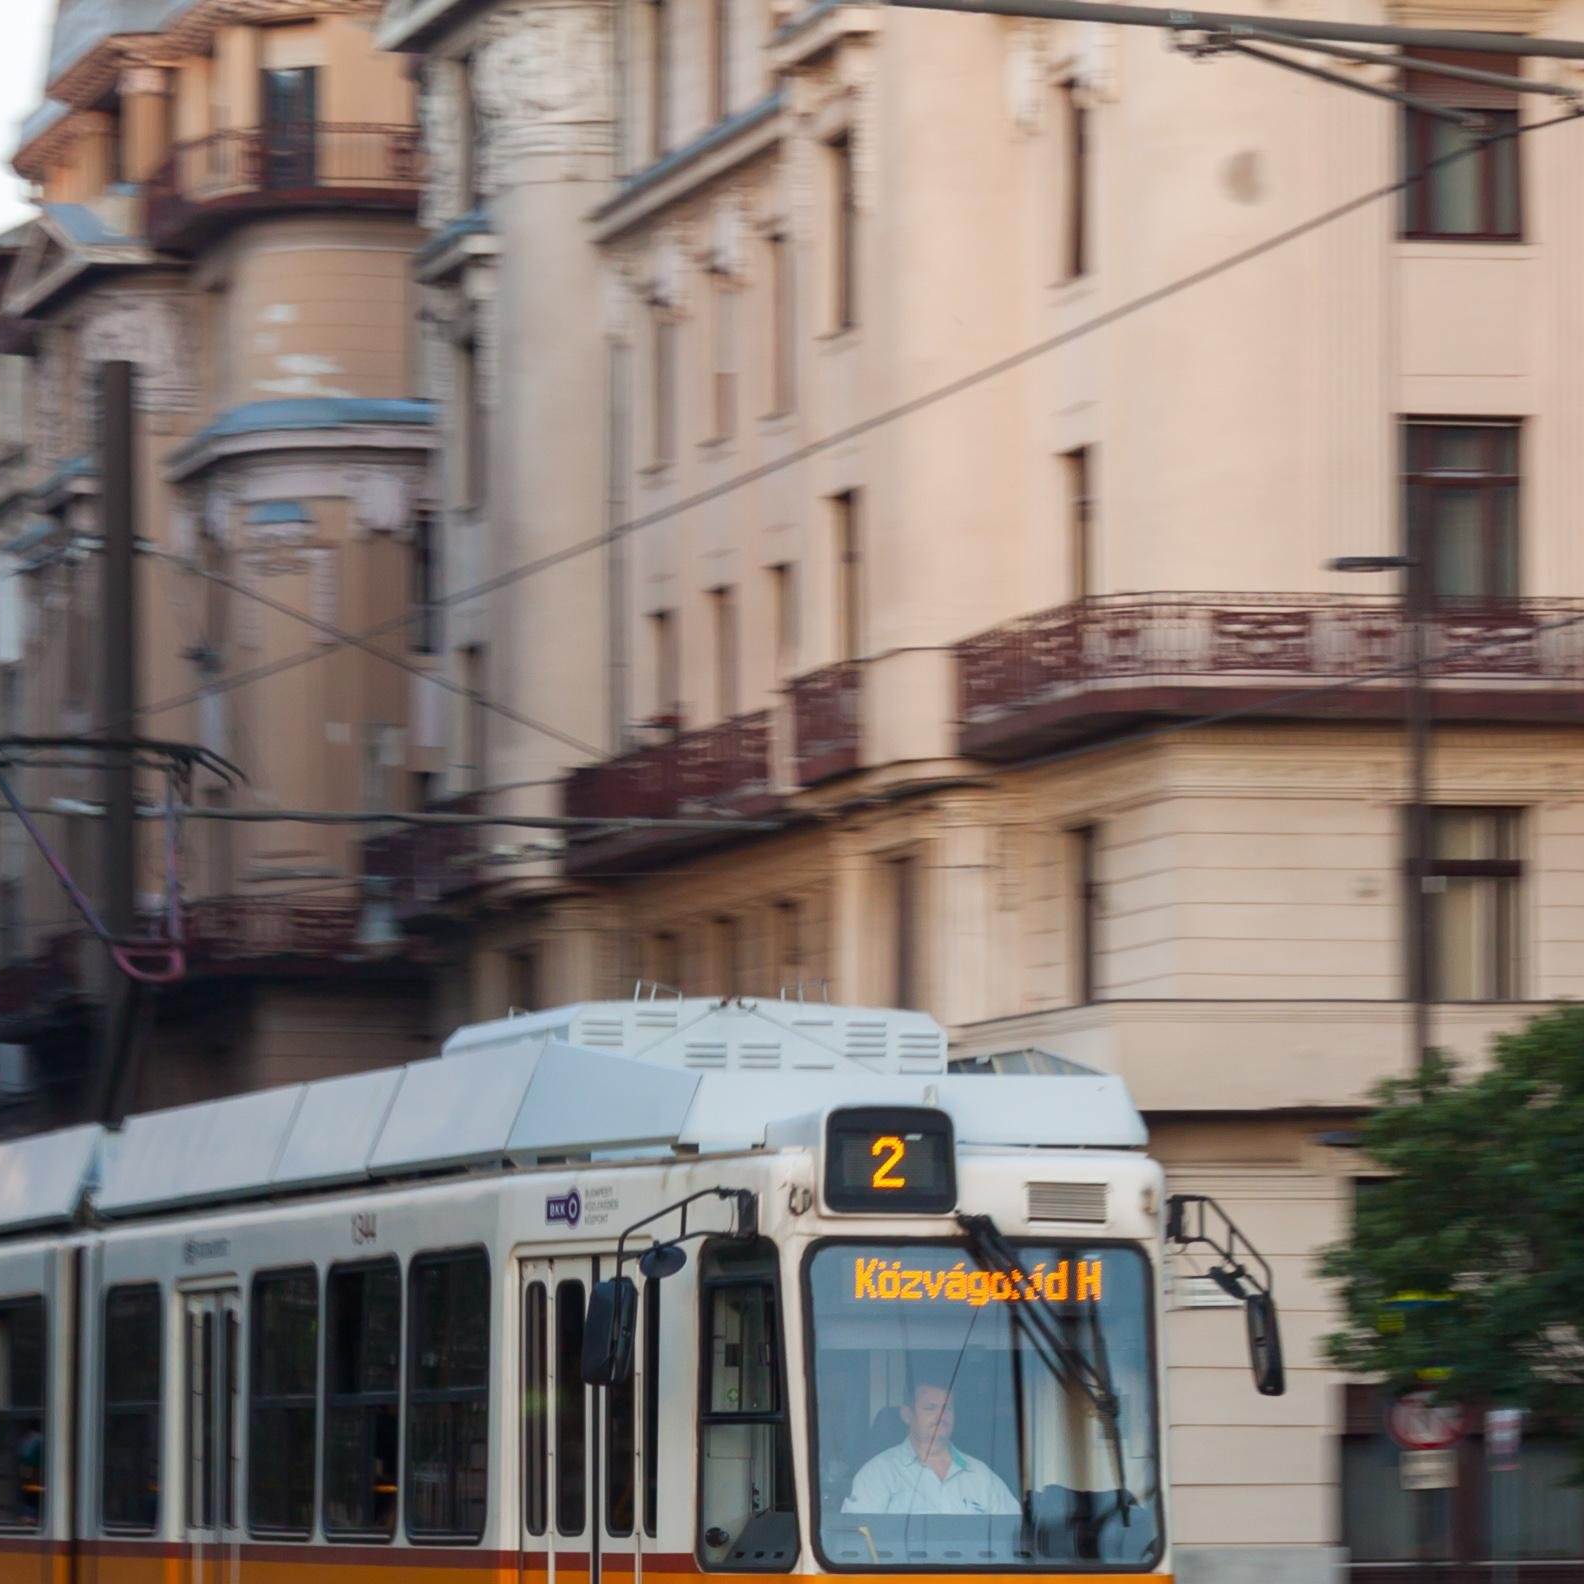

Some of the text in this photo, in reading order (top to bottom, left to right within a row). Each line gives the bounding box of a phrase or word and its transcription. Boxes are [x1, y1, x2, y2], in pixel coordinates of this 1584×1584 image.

[871, 1136, 905, 1188] 2
[549, 1202, 566, 1217] BKK
[1077, 1261, 1103, 1301] H
